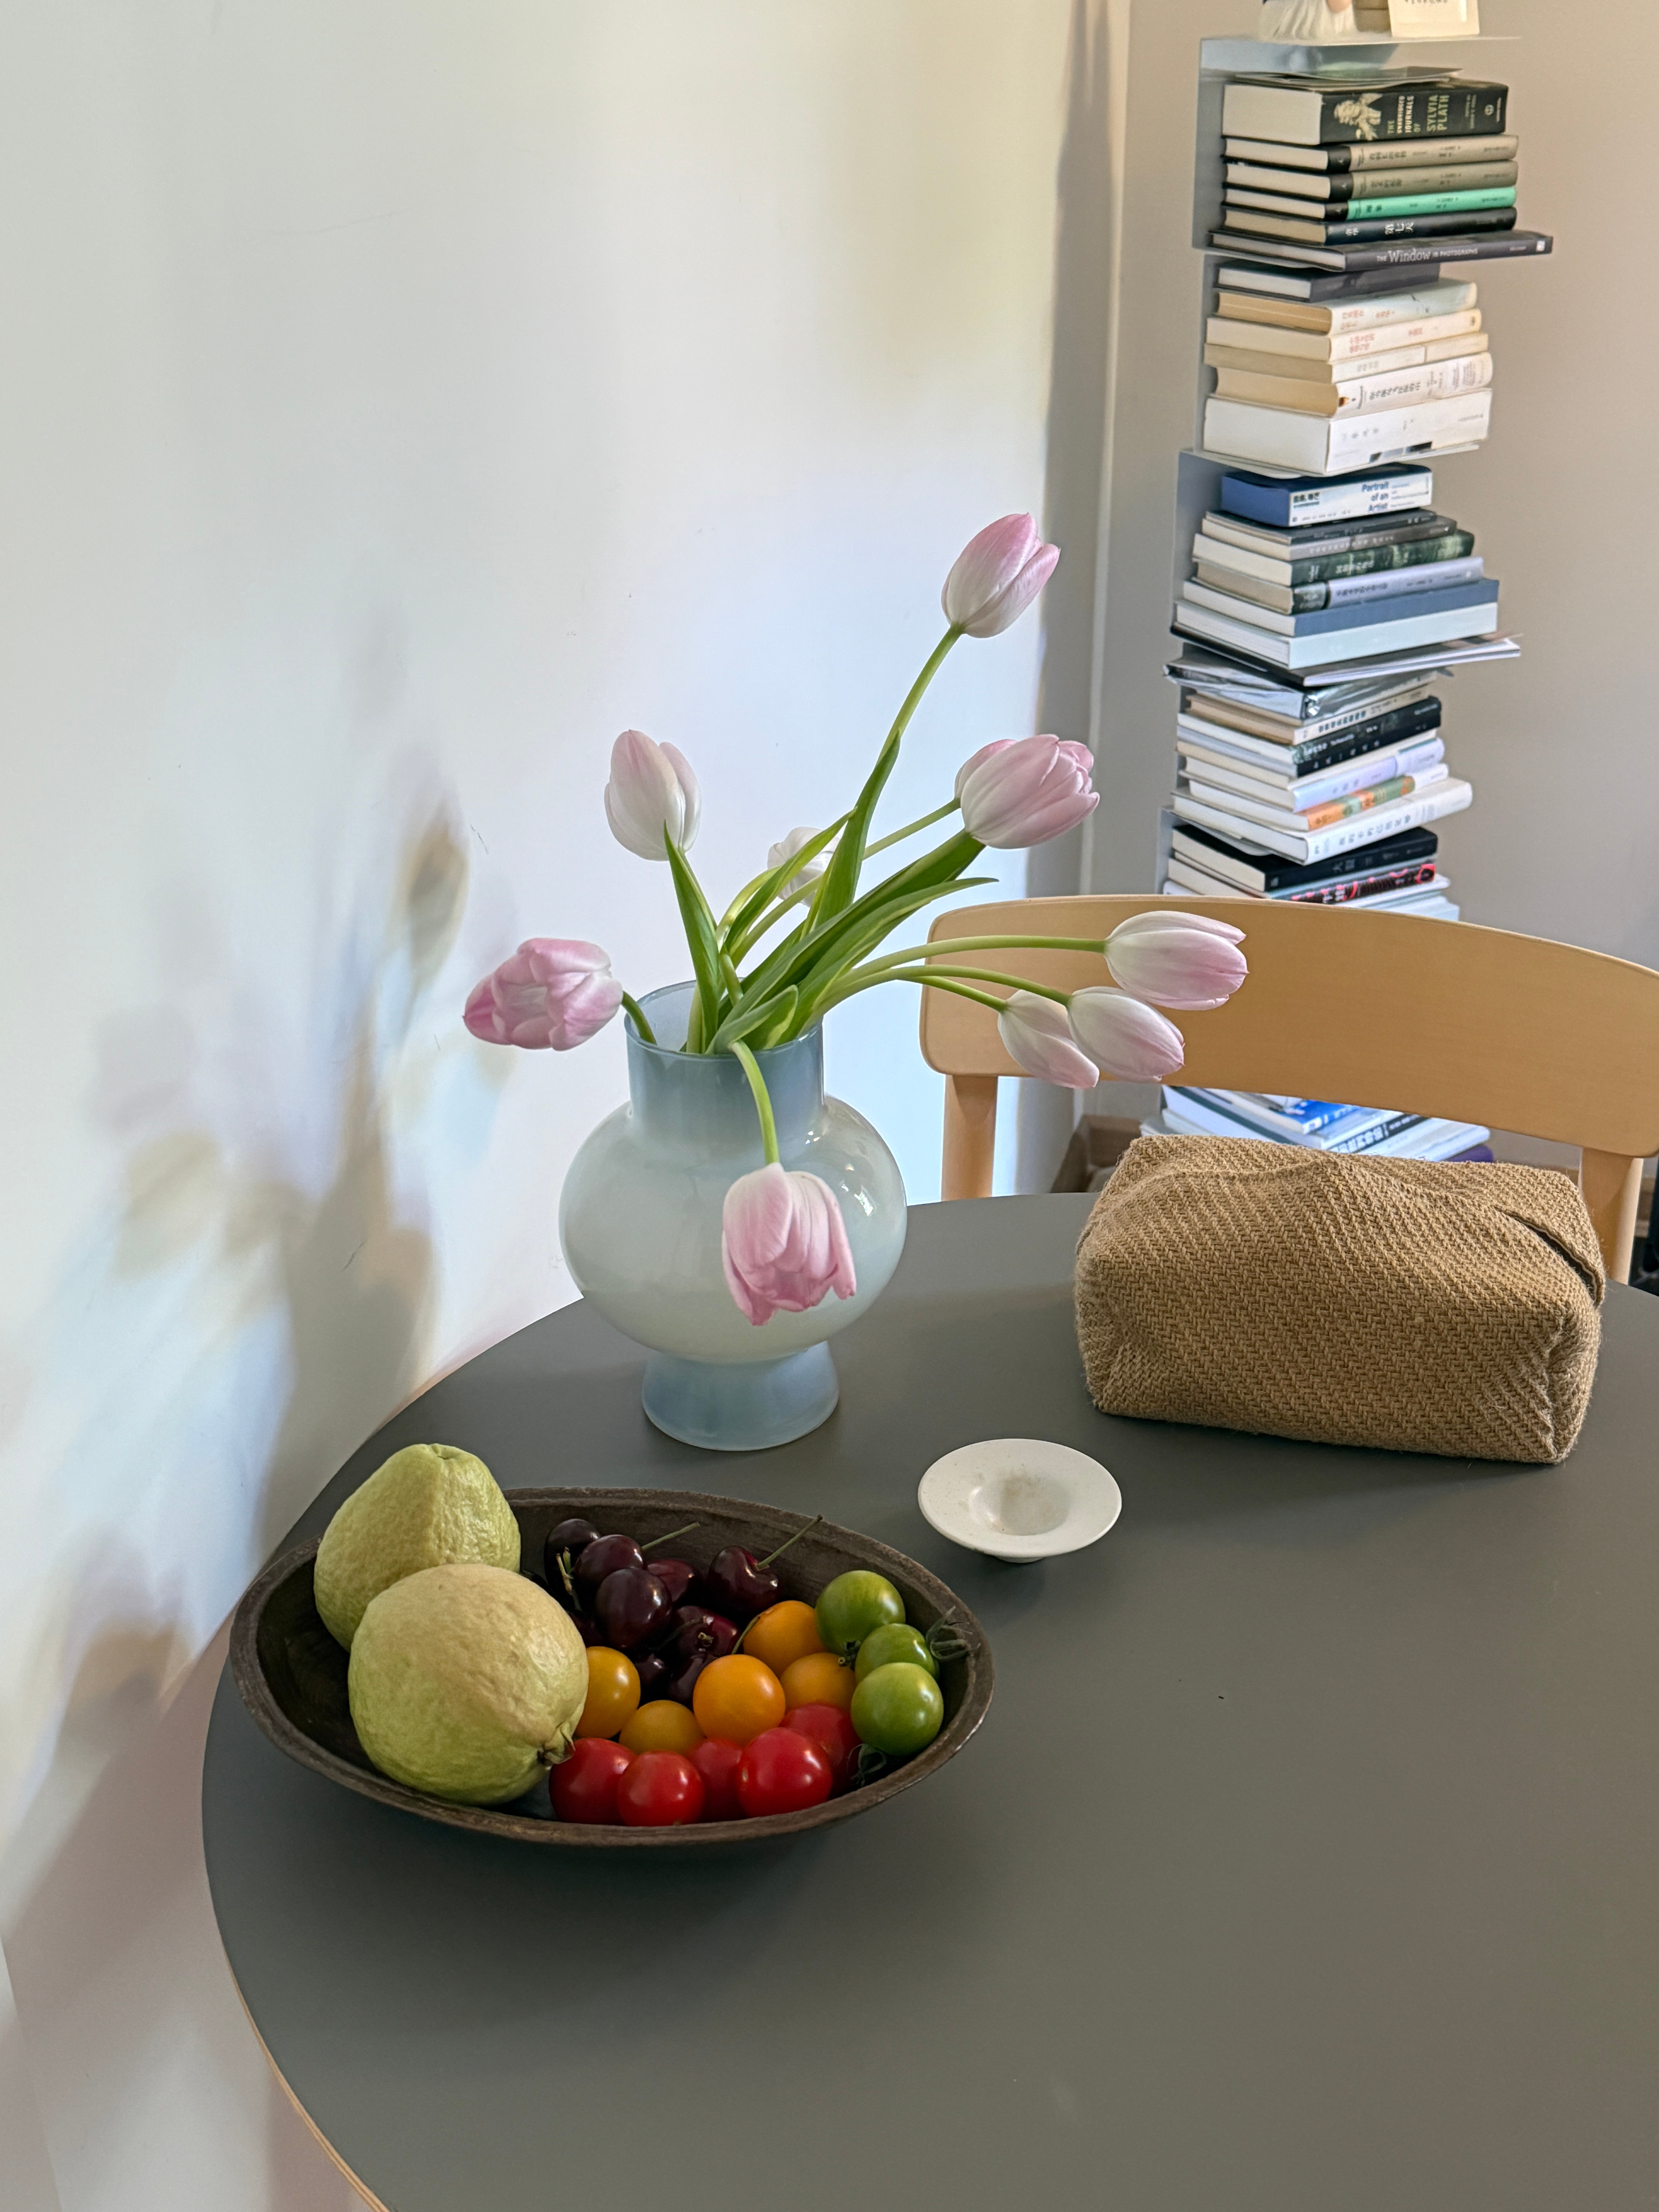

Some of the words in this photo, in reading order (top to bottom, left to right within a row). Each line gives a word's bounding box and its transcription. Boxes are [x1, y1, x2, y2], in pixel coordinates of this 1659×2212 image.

[1405, 96, 1414, 133] JOURNALS
[1427, 95, 1438, 132] SYLVIA
[1437, 95, 1449, 131] PLATH
[1413, 123, 1421, 132] OF
[1388, 248, 1431, 263] Window
[1439, 248, 1478, 257] PHOTOGRAPHS
[1362, 481, 1389, 492] Portrait
[1371, 493, 1379, 501] of
[1369, 503, 1388, 511] Artist
